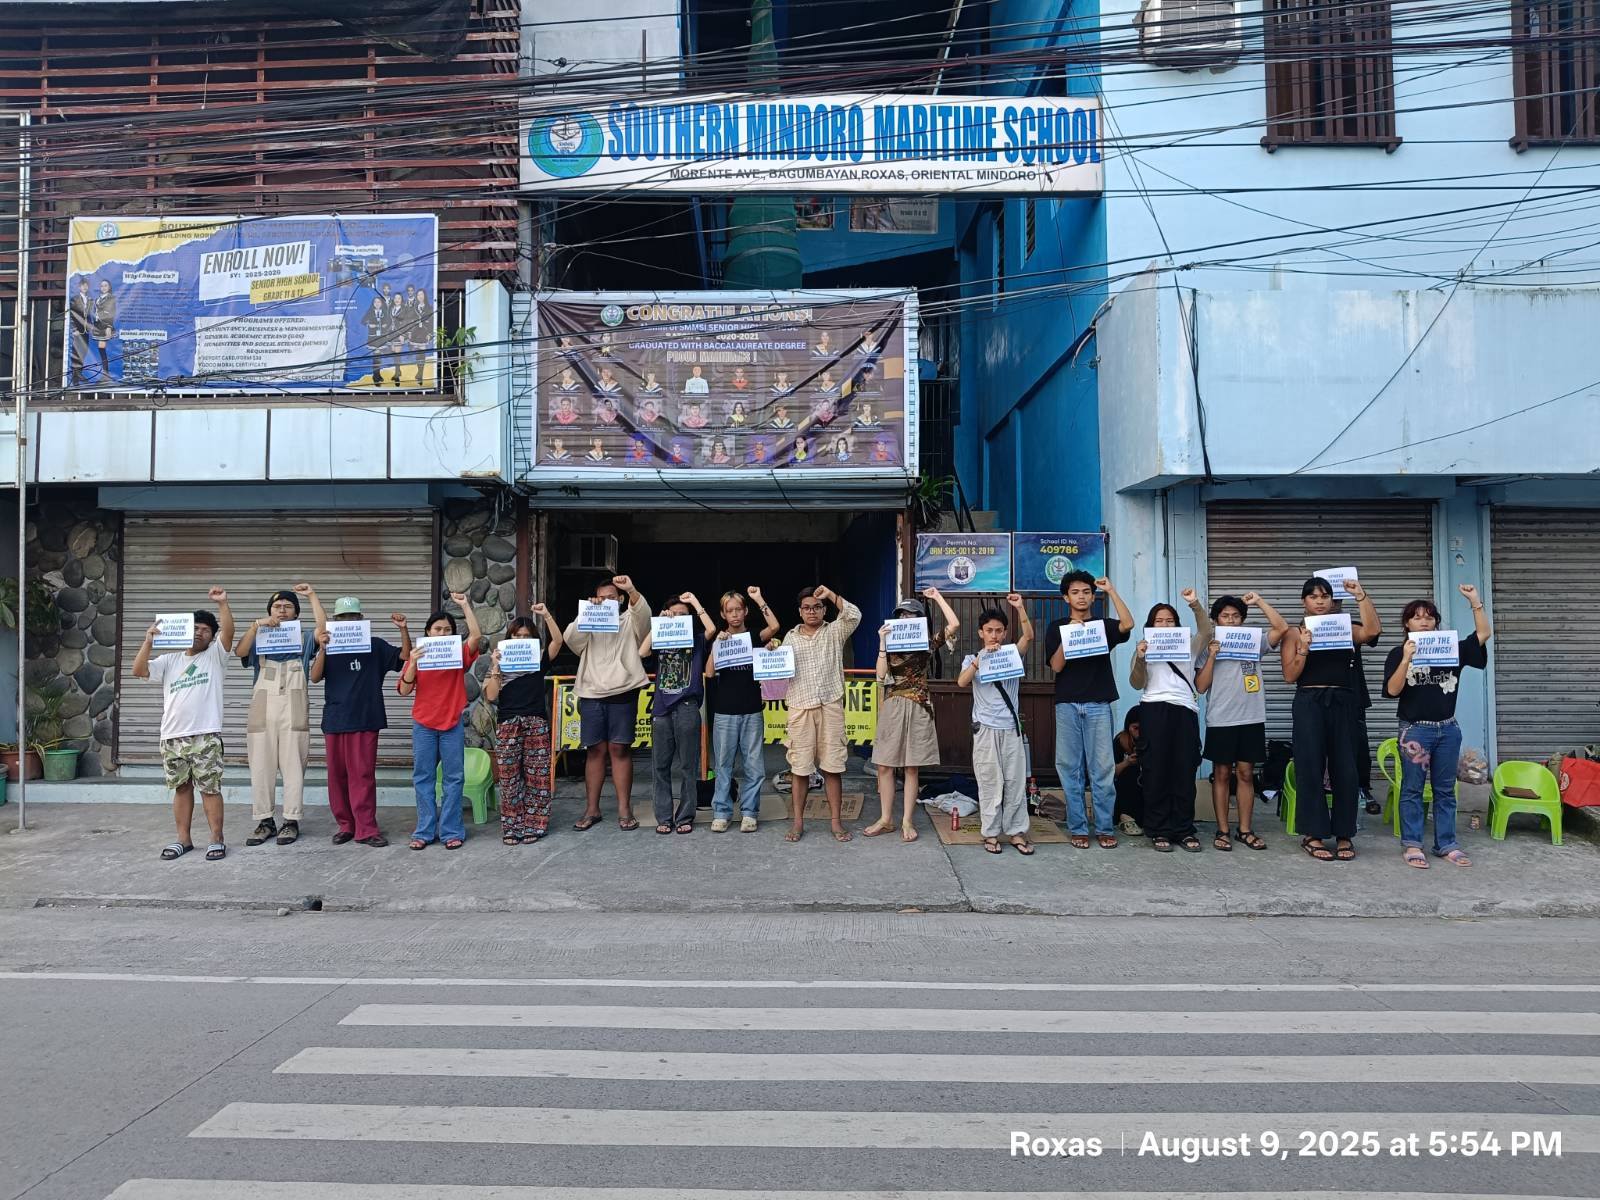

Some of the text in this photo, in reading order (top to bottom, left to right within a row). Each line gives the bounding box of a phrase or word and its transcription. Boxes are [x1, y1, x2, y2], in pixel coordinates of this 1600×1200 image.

[608, 102, 1101, 164] SOUTHERN MINDORO MARITIME SCHOOL
[670, 168, 733, 180] MORENTE
[911, 169, 973, 181] ORIENTAL
[976, 169, 1036, 181] MINDORO
[203, 244, 305, 274] ENROLL NOW!
[251, 274, 319, 290] SENIOR HIGH SCHOOL
[703, 342, 773, 350] BACCALAUREATE
[774, 342, 807, 350] DEGREE
[1040, 545, 1079, 554] 409786
[892, 623, 921, 631] STOP THE
[892, 631, 922, 641] KILLINGS!
[1070, 627, 1097, 639] STOP THE
[1225, 632, 1252, 641] DEFEND
[720, 639, 743, 649] DEFEND
[1418, 636, 1451, 645] STOP THE
[1220, 641, 1256, 650] MINDORO!
[1417, 646, 1452, 655] KILLINGS!
